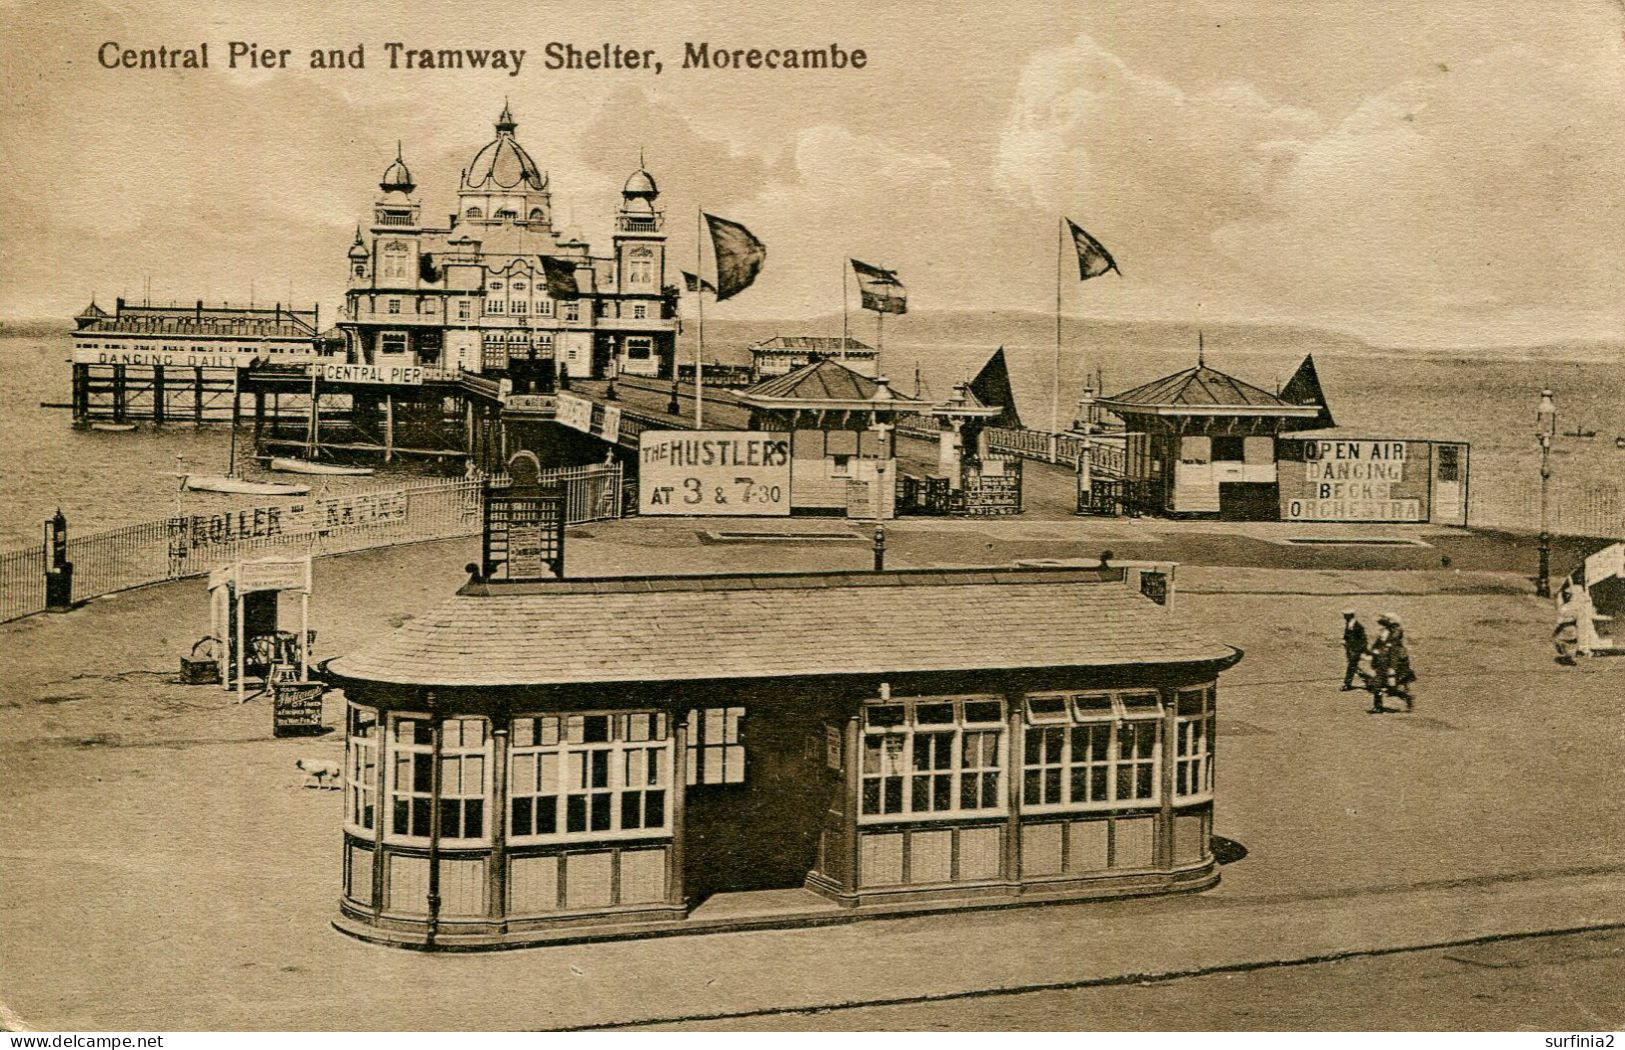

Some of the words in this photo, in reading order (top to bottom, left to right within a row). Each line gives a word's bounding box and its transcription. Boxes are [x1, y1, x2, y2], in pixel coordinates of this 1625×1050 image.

[99, 353, 174, 366] DANCING
[187, 356, 238, 367] DAILY
[327, 365, 385, 382] CENTRAL
[391, 367, 421, 384] PIER
[642, 442, 669, 463] THE
[670, 440, 789, 467] HUSTLERS
[1305, 442, 1361, 460] OPEN
[1370, 443, 1404, 460] AIR
[1309, 461, 1400, 480] DANCING
[651, 487, 675, 505] AT
[683, 477, 703, 504] 3
[714, 486, 728, 505] &
[1319, 483, 1390, 500] BECKS
[1290, 500, 1418, 518] ORCHESTRA
[191, 506, 282, 549] ROLLER
